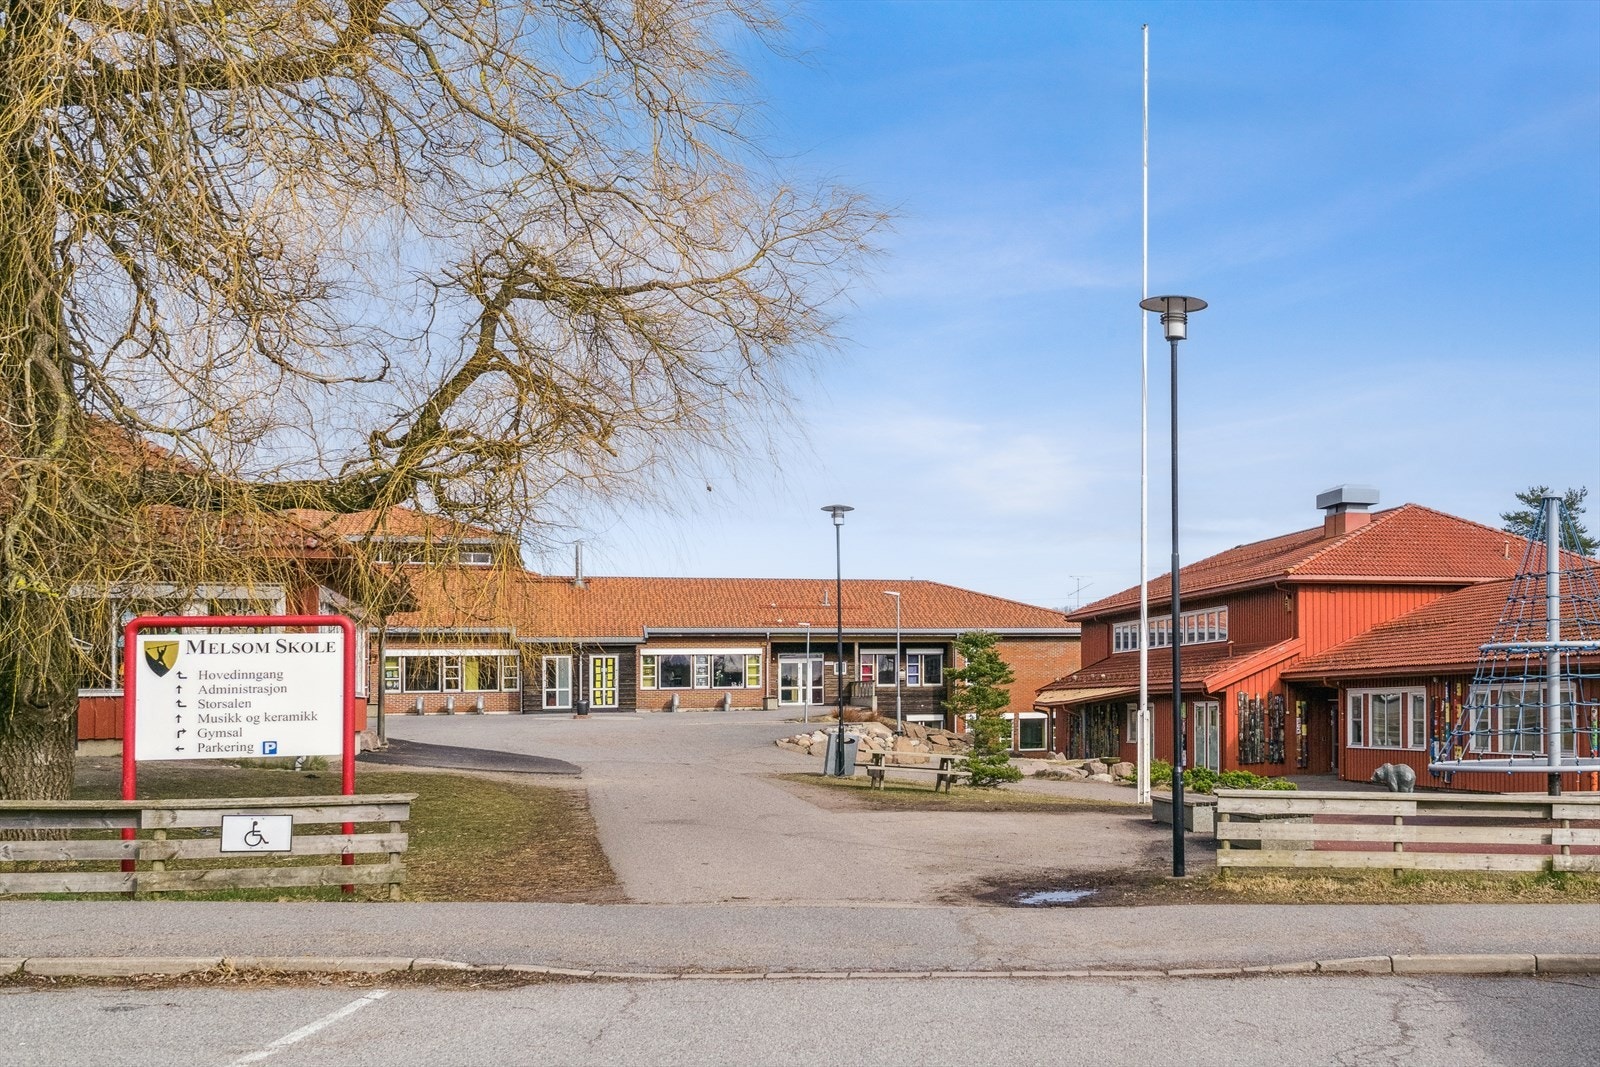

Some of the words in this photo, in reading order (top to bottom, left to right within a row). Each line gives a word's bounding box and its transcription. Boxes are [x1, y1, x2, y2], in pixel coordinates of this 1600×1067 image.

[186, 639, 270, 655] MELSOM
[275, 638, 336, 655] SKOLE
[198, 669, 284, 682] Hovedinngang
[198, 684, 288, 696] Administrasjon
[197, 698, 252, 709] Storsalen
[197, 712, 242, 724] Musikk
[245, 715, 261, 725] og
[264, 711, 318, 722] keramikk
[197, 727, 243, 740] Gymsal
[197, 742, 254, 754] Parkering
[264, 742, 276, 754] P
